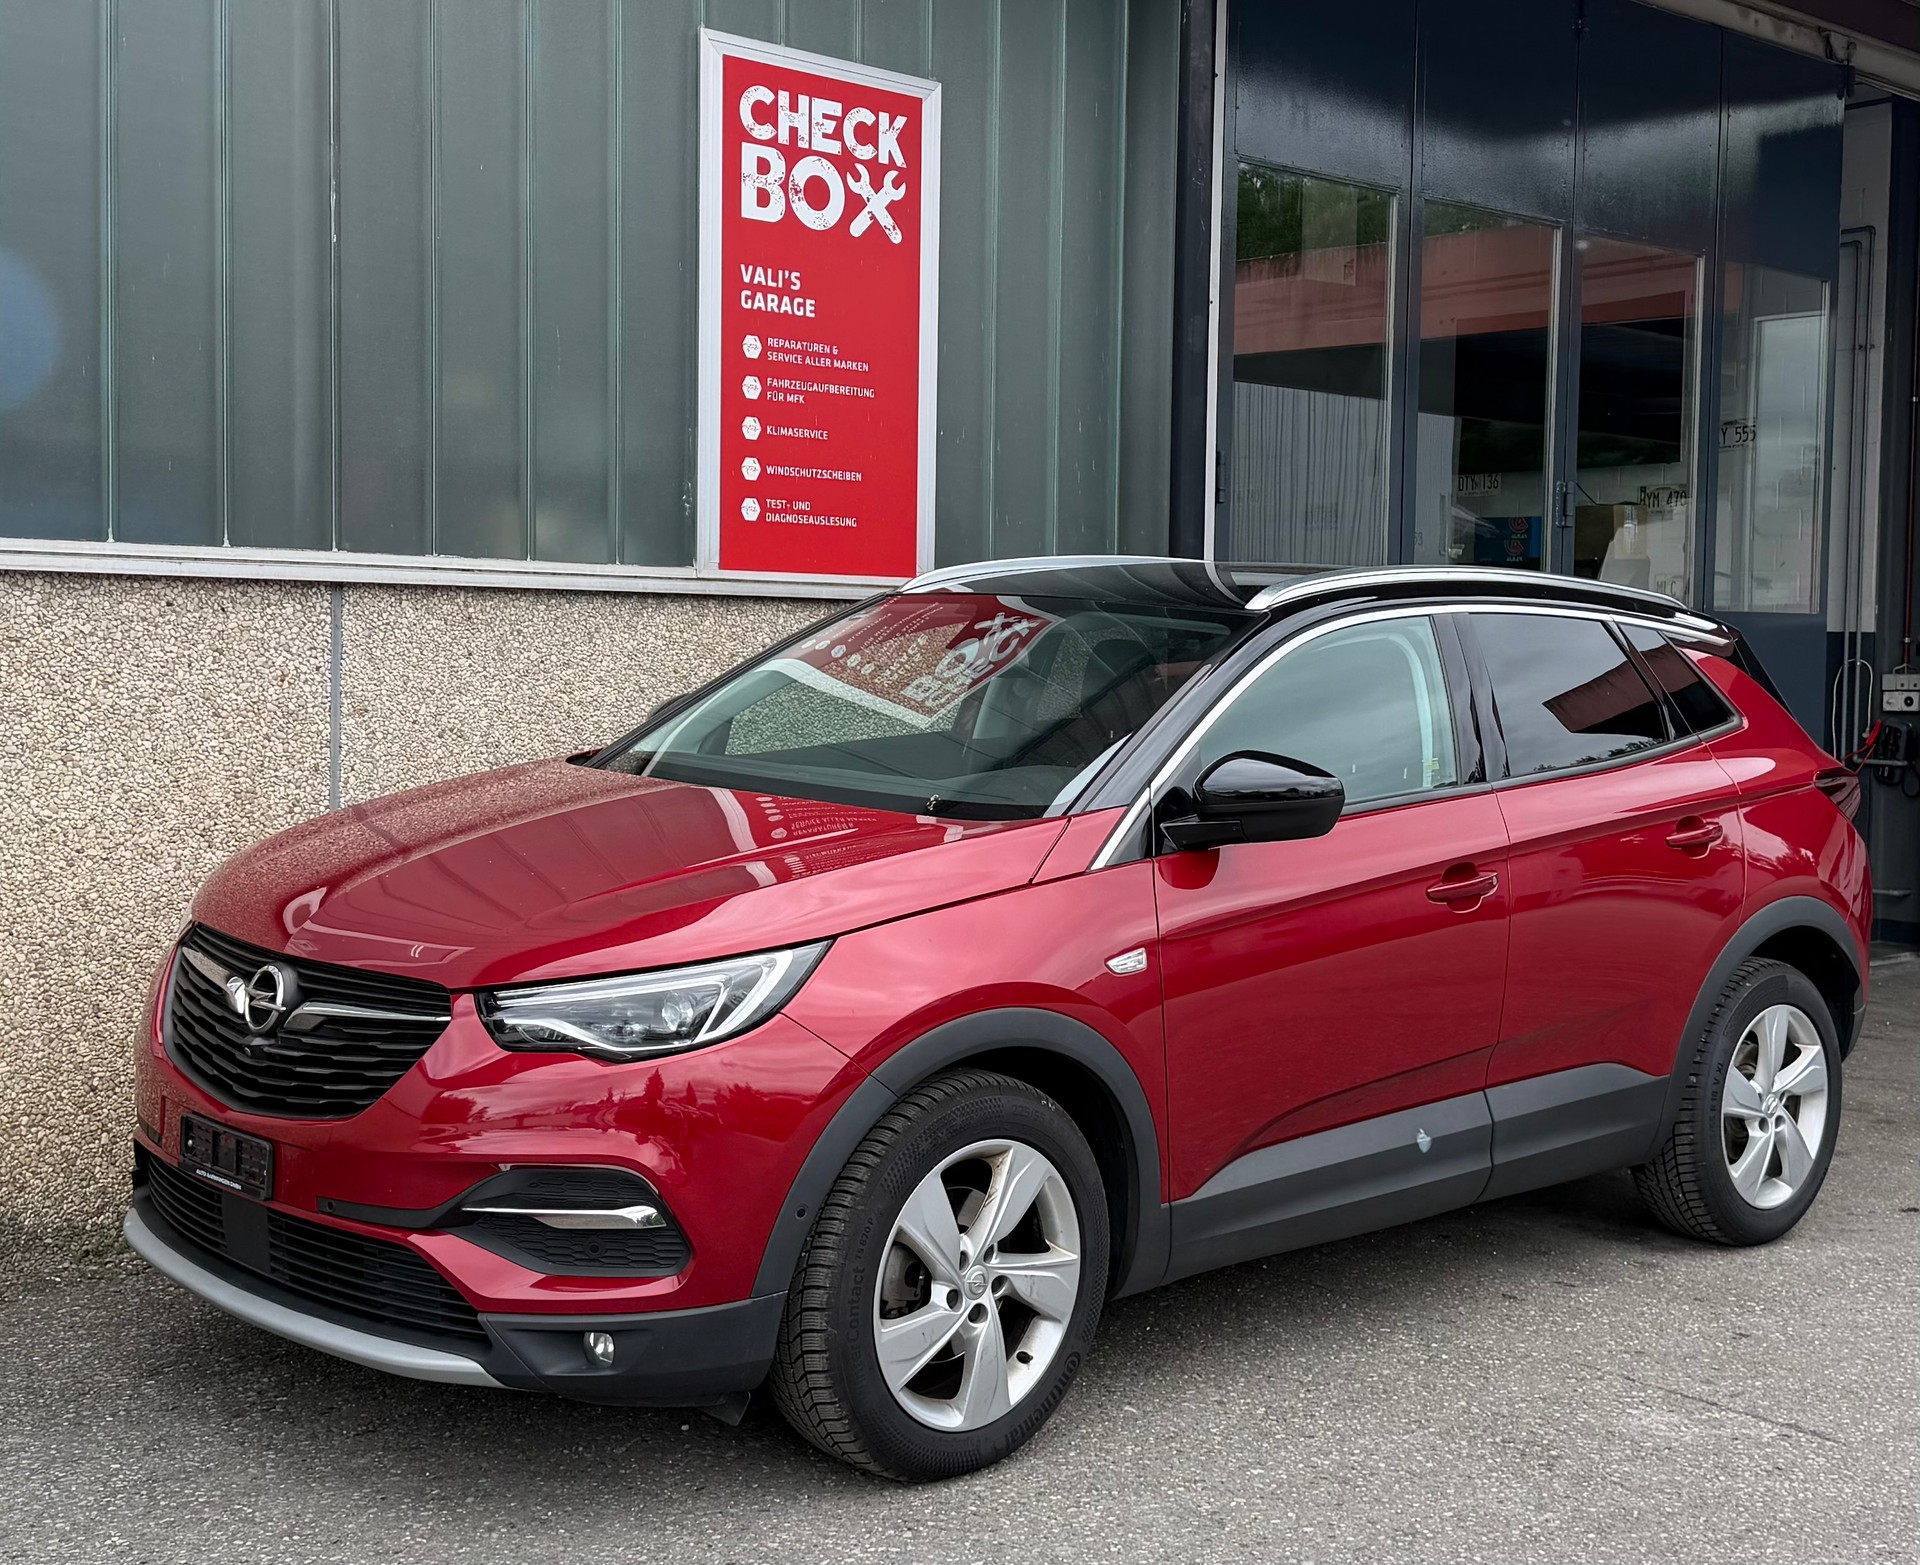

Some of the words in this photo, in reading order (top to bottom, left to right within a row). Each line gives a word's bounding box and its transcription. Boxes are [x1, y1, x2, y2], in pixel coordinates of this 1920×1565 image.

[739, 84, 909, 169] CHECK
[740, 141, 907, 245] BOX
[740, 263, 801, 291] VALI'S
[740, 289, 816, 318] GARAGE
[767, 337, 831, 354] REPARATUREN
[832, 345, 839, 355] &
[767, 351, 803, 365] SERVICE
[804, 355, 832, 368] ALLER
[833, 359, 869, 372] MARKEN
[767, 377, 875, 398] FAHRZEUGAUFBEREITUNG
[767, 390, 785, 402] FÜR
[786, 393, 805, 404] MFK
[766, 425, 829, 440] KLIMASERVICE
[766, 465, 862, 482] WINDSCHUTZSCHEIBEN
[1458, 476, 1475, 491] DTY
[1482, 473, 1499, 490] 136
[766, 498, 790, 510] TEST-
[792, 501, 811, 511] UND
[765, 512, 857, 527] DIAGNOSEAUSLESUNG
